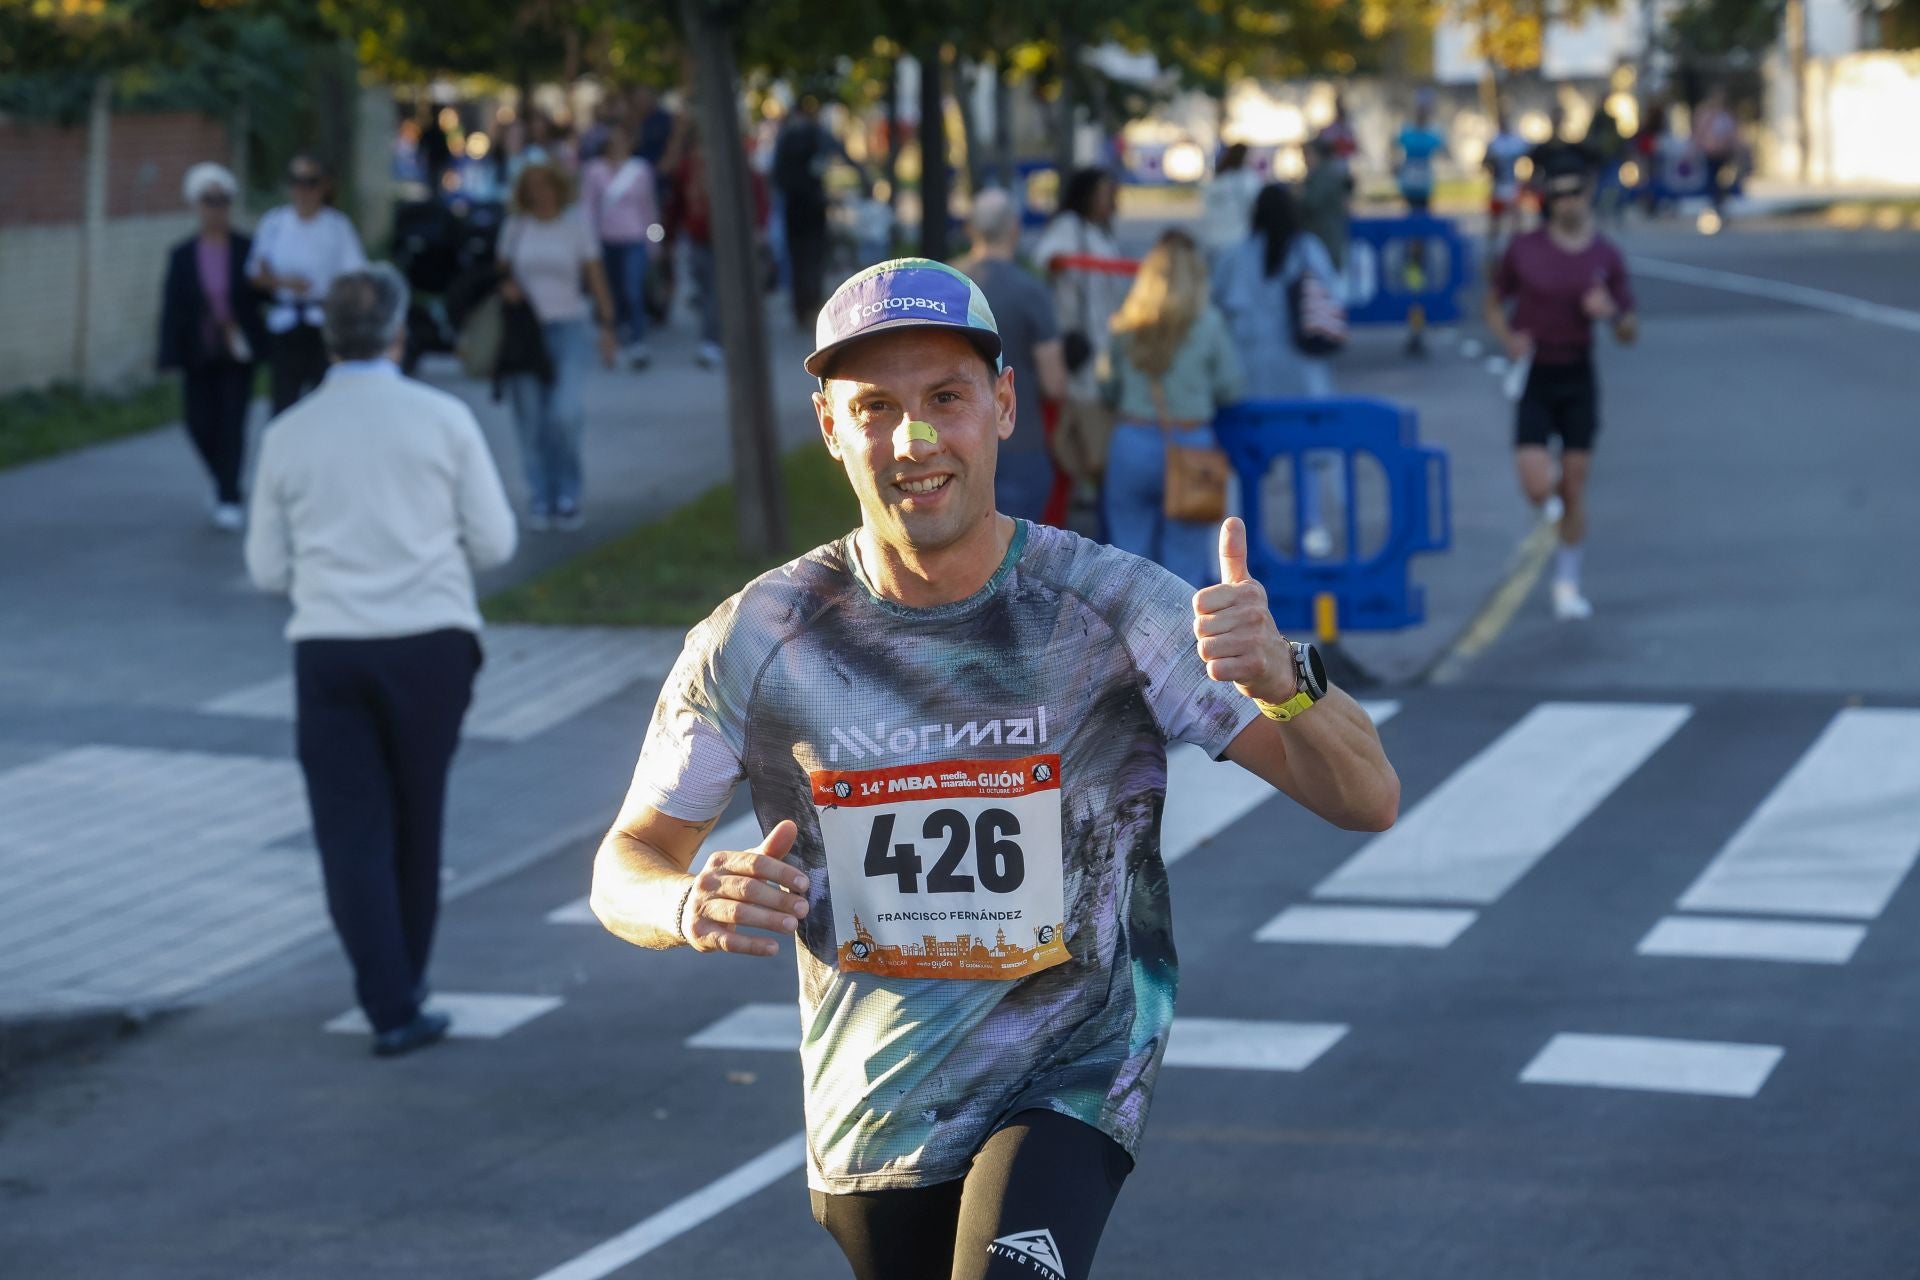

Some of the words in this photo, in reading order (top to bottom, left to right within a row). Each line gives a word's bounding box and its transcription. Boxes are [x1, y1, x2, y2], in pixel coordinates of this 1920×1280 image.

[862, 297, 947, 317] cotopaxi
[888, 775, 937, 793] MBA
[940, 771, 968, 781] media
[940, 779, 977, 788] maratón
[977, 770, 1025, 788] GIJÓN
[863, 808, 1025, 894] 426
[877, 911, 947, 922] FRANCISCO
[950, 909, 1022, 921] FERNÁNDEZ
[986, 1243, 1027, 1265] NIKE
